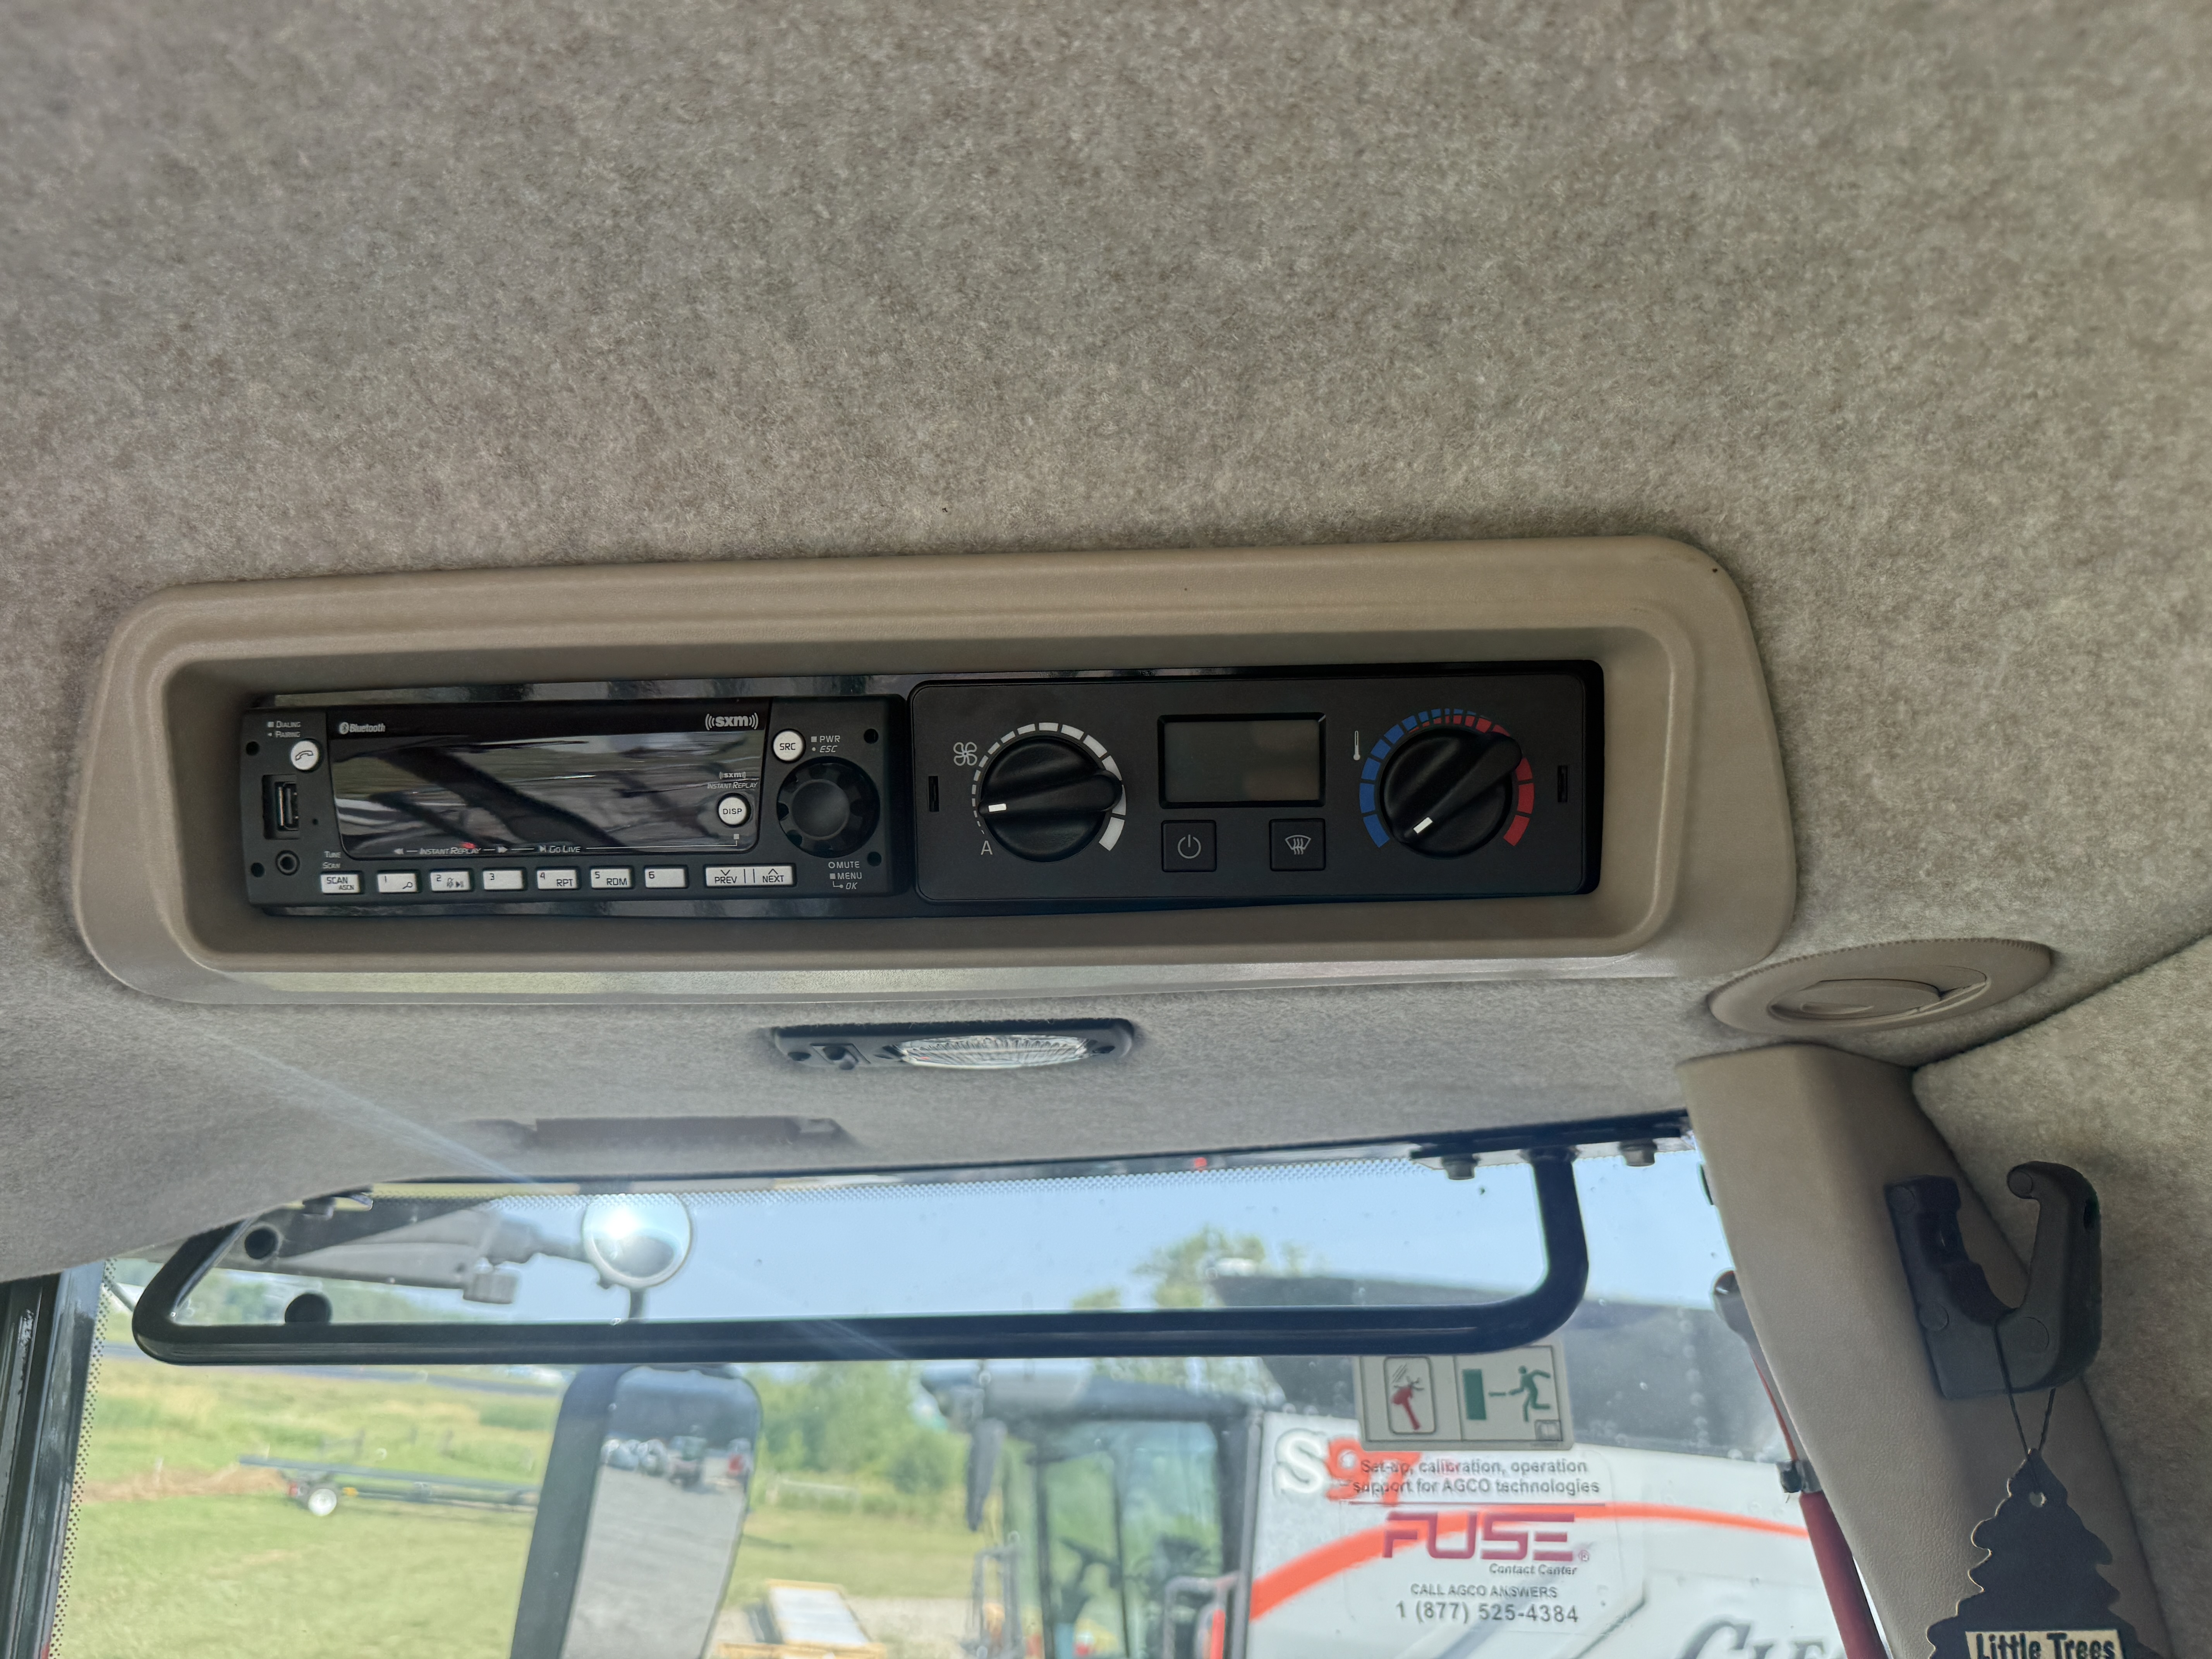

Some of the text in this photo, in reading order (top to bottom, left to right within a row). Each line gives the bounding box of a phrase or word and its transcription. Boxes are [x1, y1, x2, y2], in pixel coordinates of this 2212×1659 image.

[349, 723, 386, 733] Bluetooth
[981, 840, 993, 855] A
[556, 879, 573, 887] RPT
[1419, 1458, 1506, 1475] calibration,
[1511, 1458, 1587, 1476] operation
[1353, 1477, 1600, 1497] support for AGCO technologies
[1382, 1511, 1575, 1562] FUSE
[1489, 1563, 1578, 1576] Contact Center
[1411, 1583, 1558, 1599] CALL AGCO ANSWERS
[1396, 1600, 1579, 1624] 1 (877) 525-4384
[1976, 1632, 2116, 1659] Little Trees
